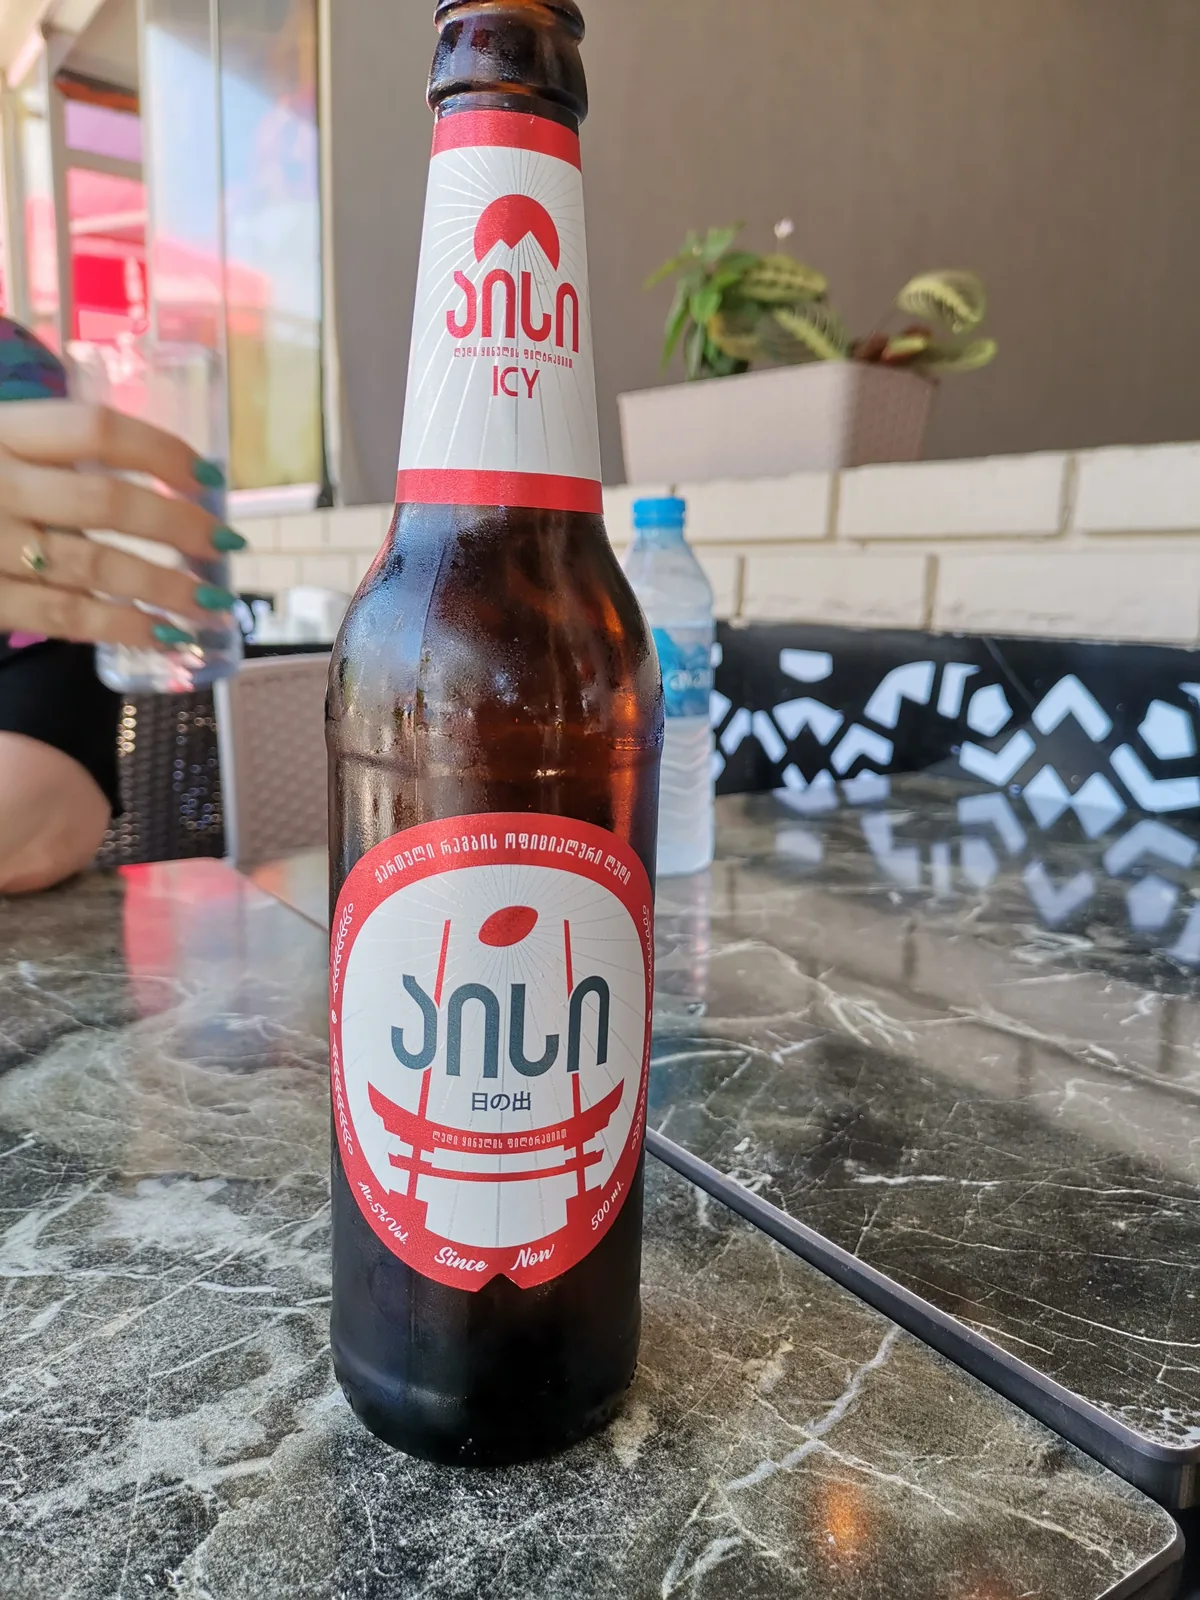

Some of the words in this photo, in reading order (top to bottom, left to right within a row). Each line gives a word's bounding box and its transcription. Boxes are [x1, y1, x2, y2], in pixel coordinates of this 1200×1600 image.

[492, 365, 541, 399] ICY
[374, 842, 436, 884] ქართული
[504, 832, 603, 865] ოფიციალური
[604, 854, 632, 886] ლუდი
[471, 1090, 532, 1112] 日の出
[432, 1130, 459, 1146] ლუდი
[590, 1199, 611, 1231] 500
[433, 1246, 489, 1272] Since
[510, 1243, 555, 1271] Now
